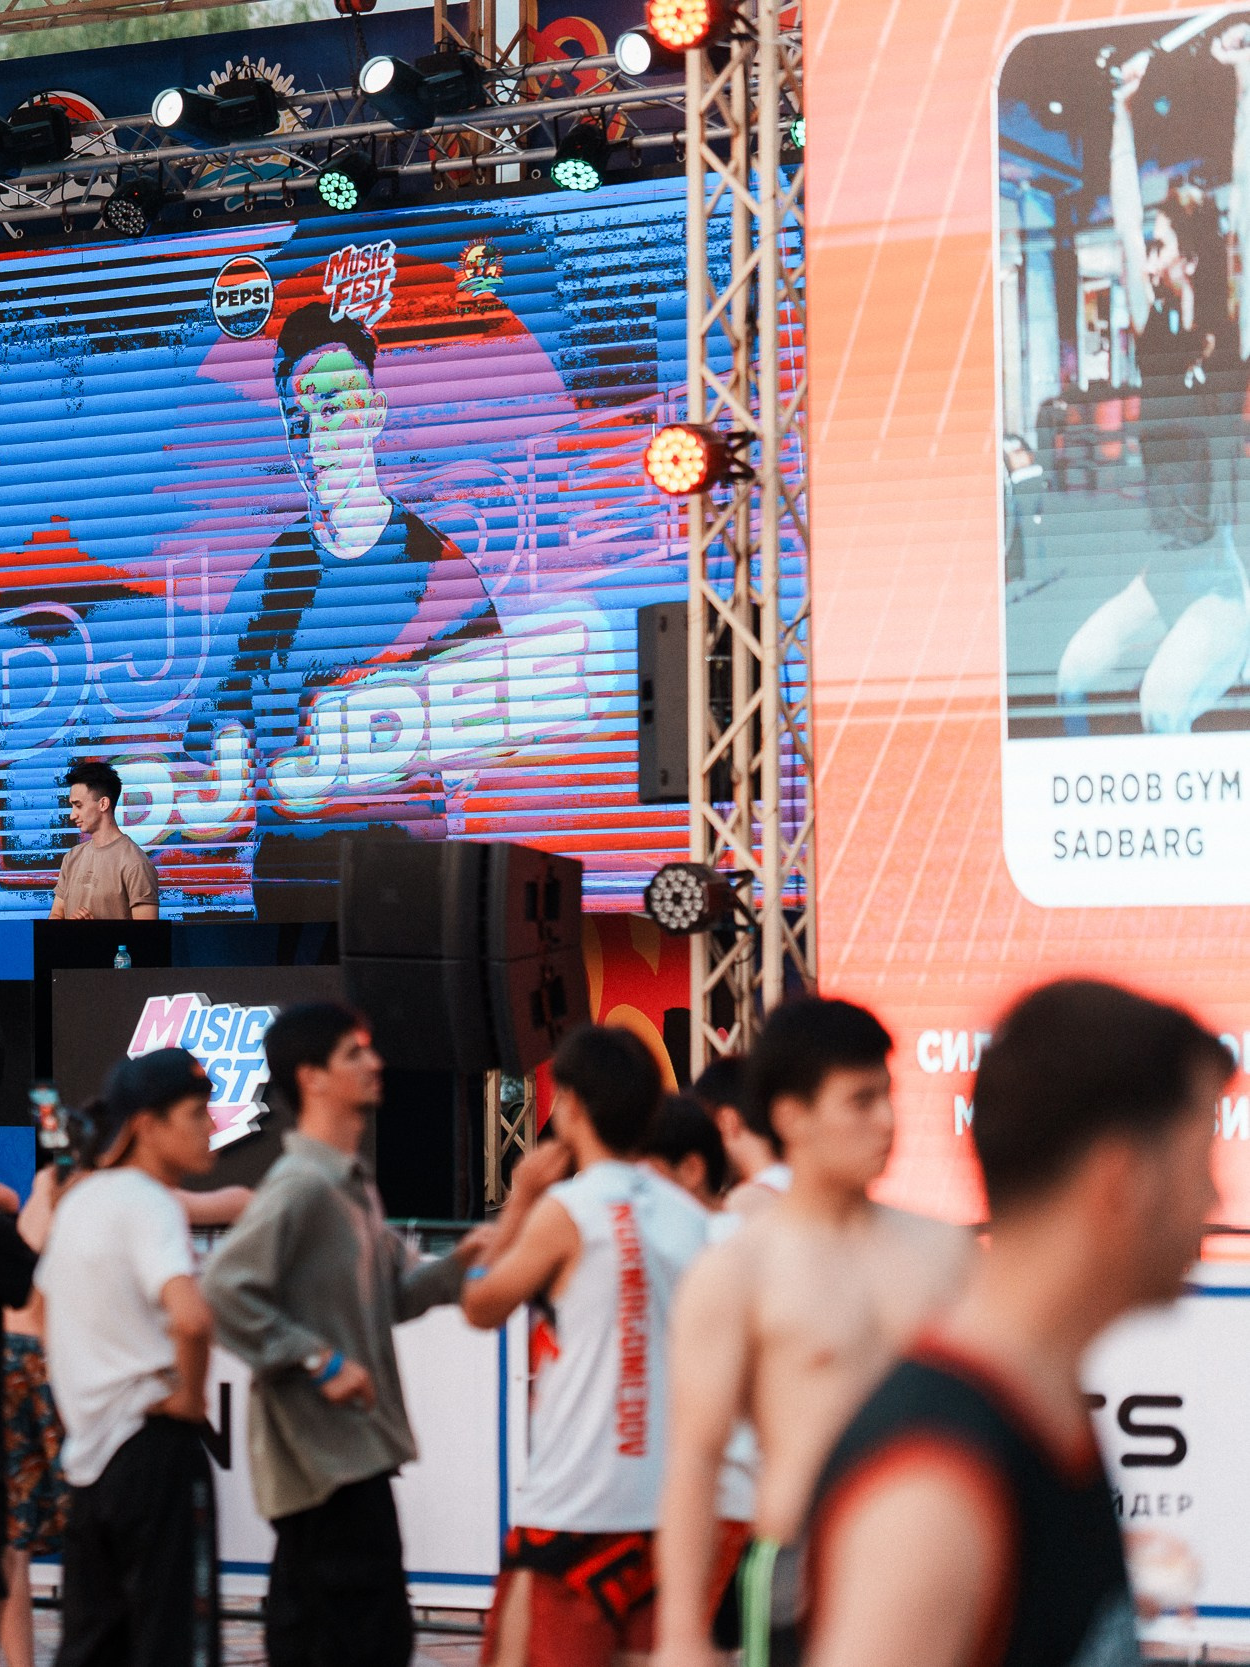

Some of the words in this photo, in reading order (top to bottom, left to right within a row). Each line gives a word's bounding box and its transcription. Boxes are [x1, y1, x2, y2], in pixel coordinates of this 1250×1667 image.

[325, 240, 393, 288] MUSIC
[216, 286, 270, 308] PEPSI
[330, 266, 392, 316] FEST
[268, 616, 592, 806] JDEE
[1053, 772, 1162, 804] DOROB
[1175, 770, 1241, 801] GYM
[1053, 827, 1204, 859] SADBARG
[130, 996, 271, 1054] MUSIC
